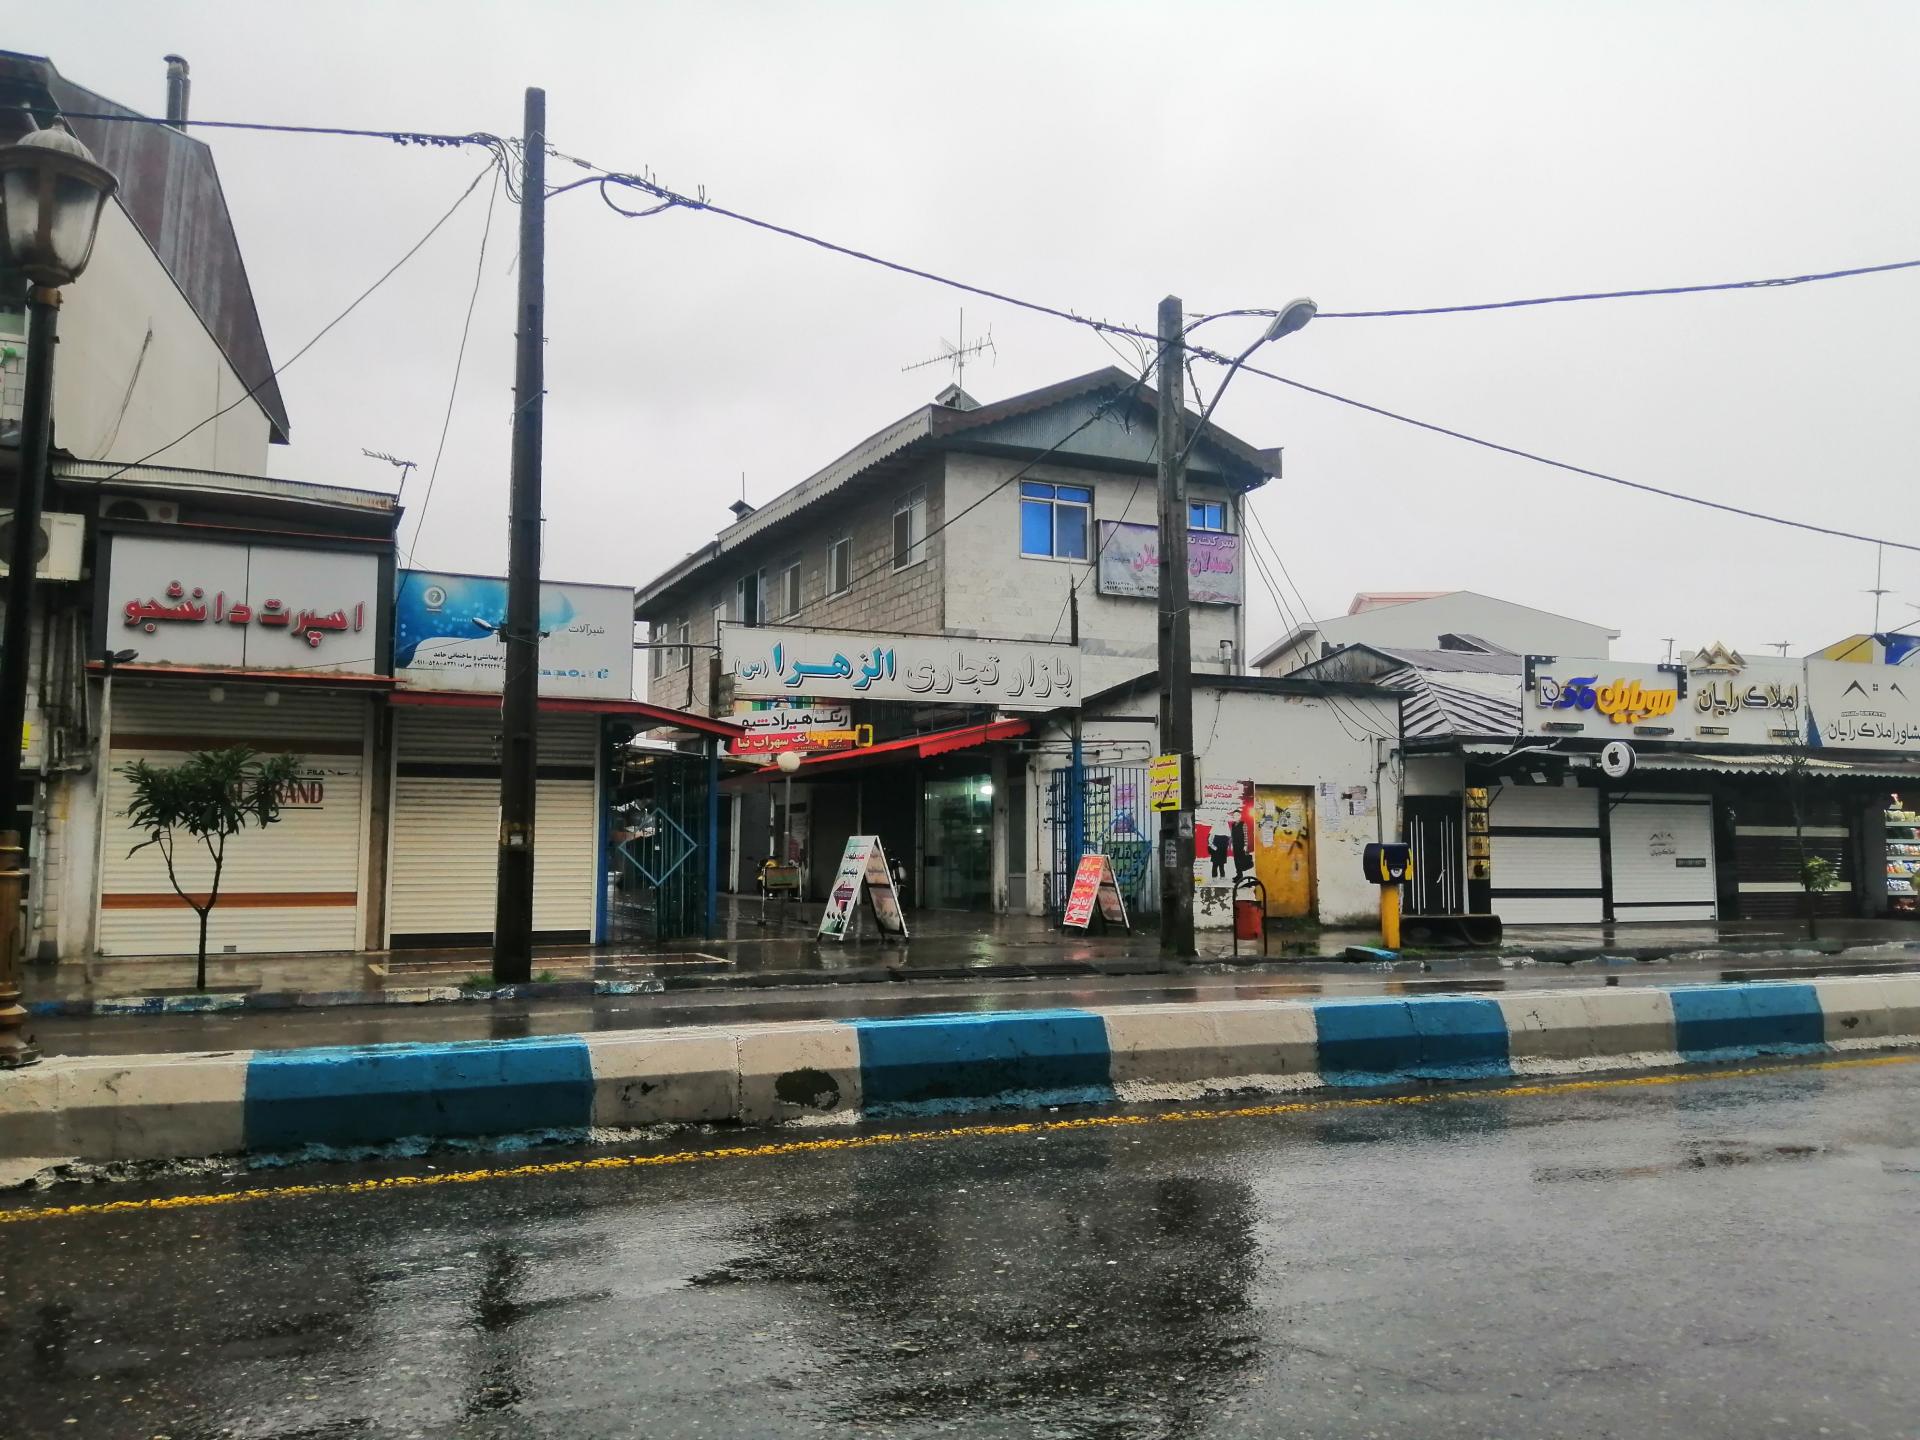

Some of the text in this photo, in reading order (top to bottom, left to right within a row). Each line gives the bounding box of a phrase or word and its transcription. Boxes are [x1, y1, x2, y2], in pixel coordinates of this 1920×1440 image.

[1199, 536, 1236, 550] شرکت
[122, 579, 366, 649] اسپرت دانشجو
[568, 623, 606, 637] شیرآلات
[770, 639, 898, 693] الزهرا
[903, 650, 1001, 694] تجاری
[1005, 654, 1074, 698] بازار
[1595, 678, 1679, 723] موبایل
[1698, 680, 1799, 716] املاک رایان
[772, 711, 813, 730] هیراد
[814, 707, 849, 727] رنگ
[1828, 719, 1857, 742] رایان
[1893, 721, 1920, 745] شاور
[737, 735, 751, 751] نیا
[753, 736, 789, 750] سهراب
[268, 780, 324, 805] RAND
